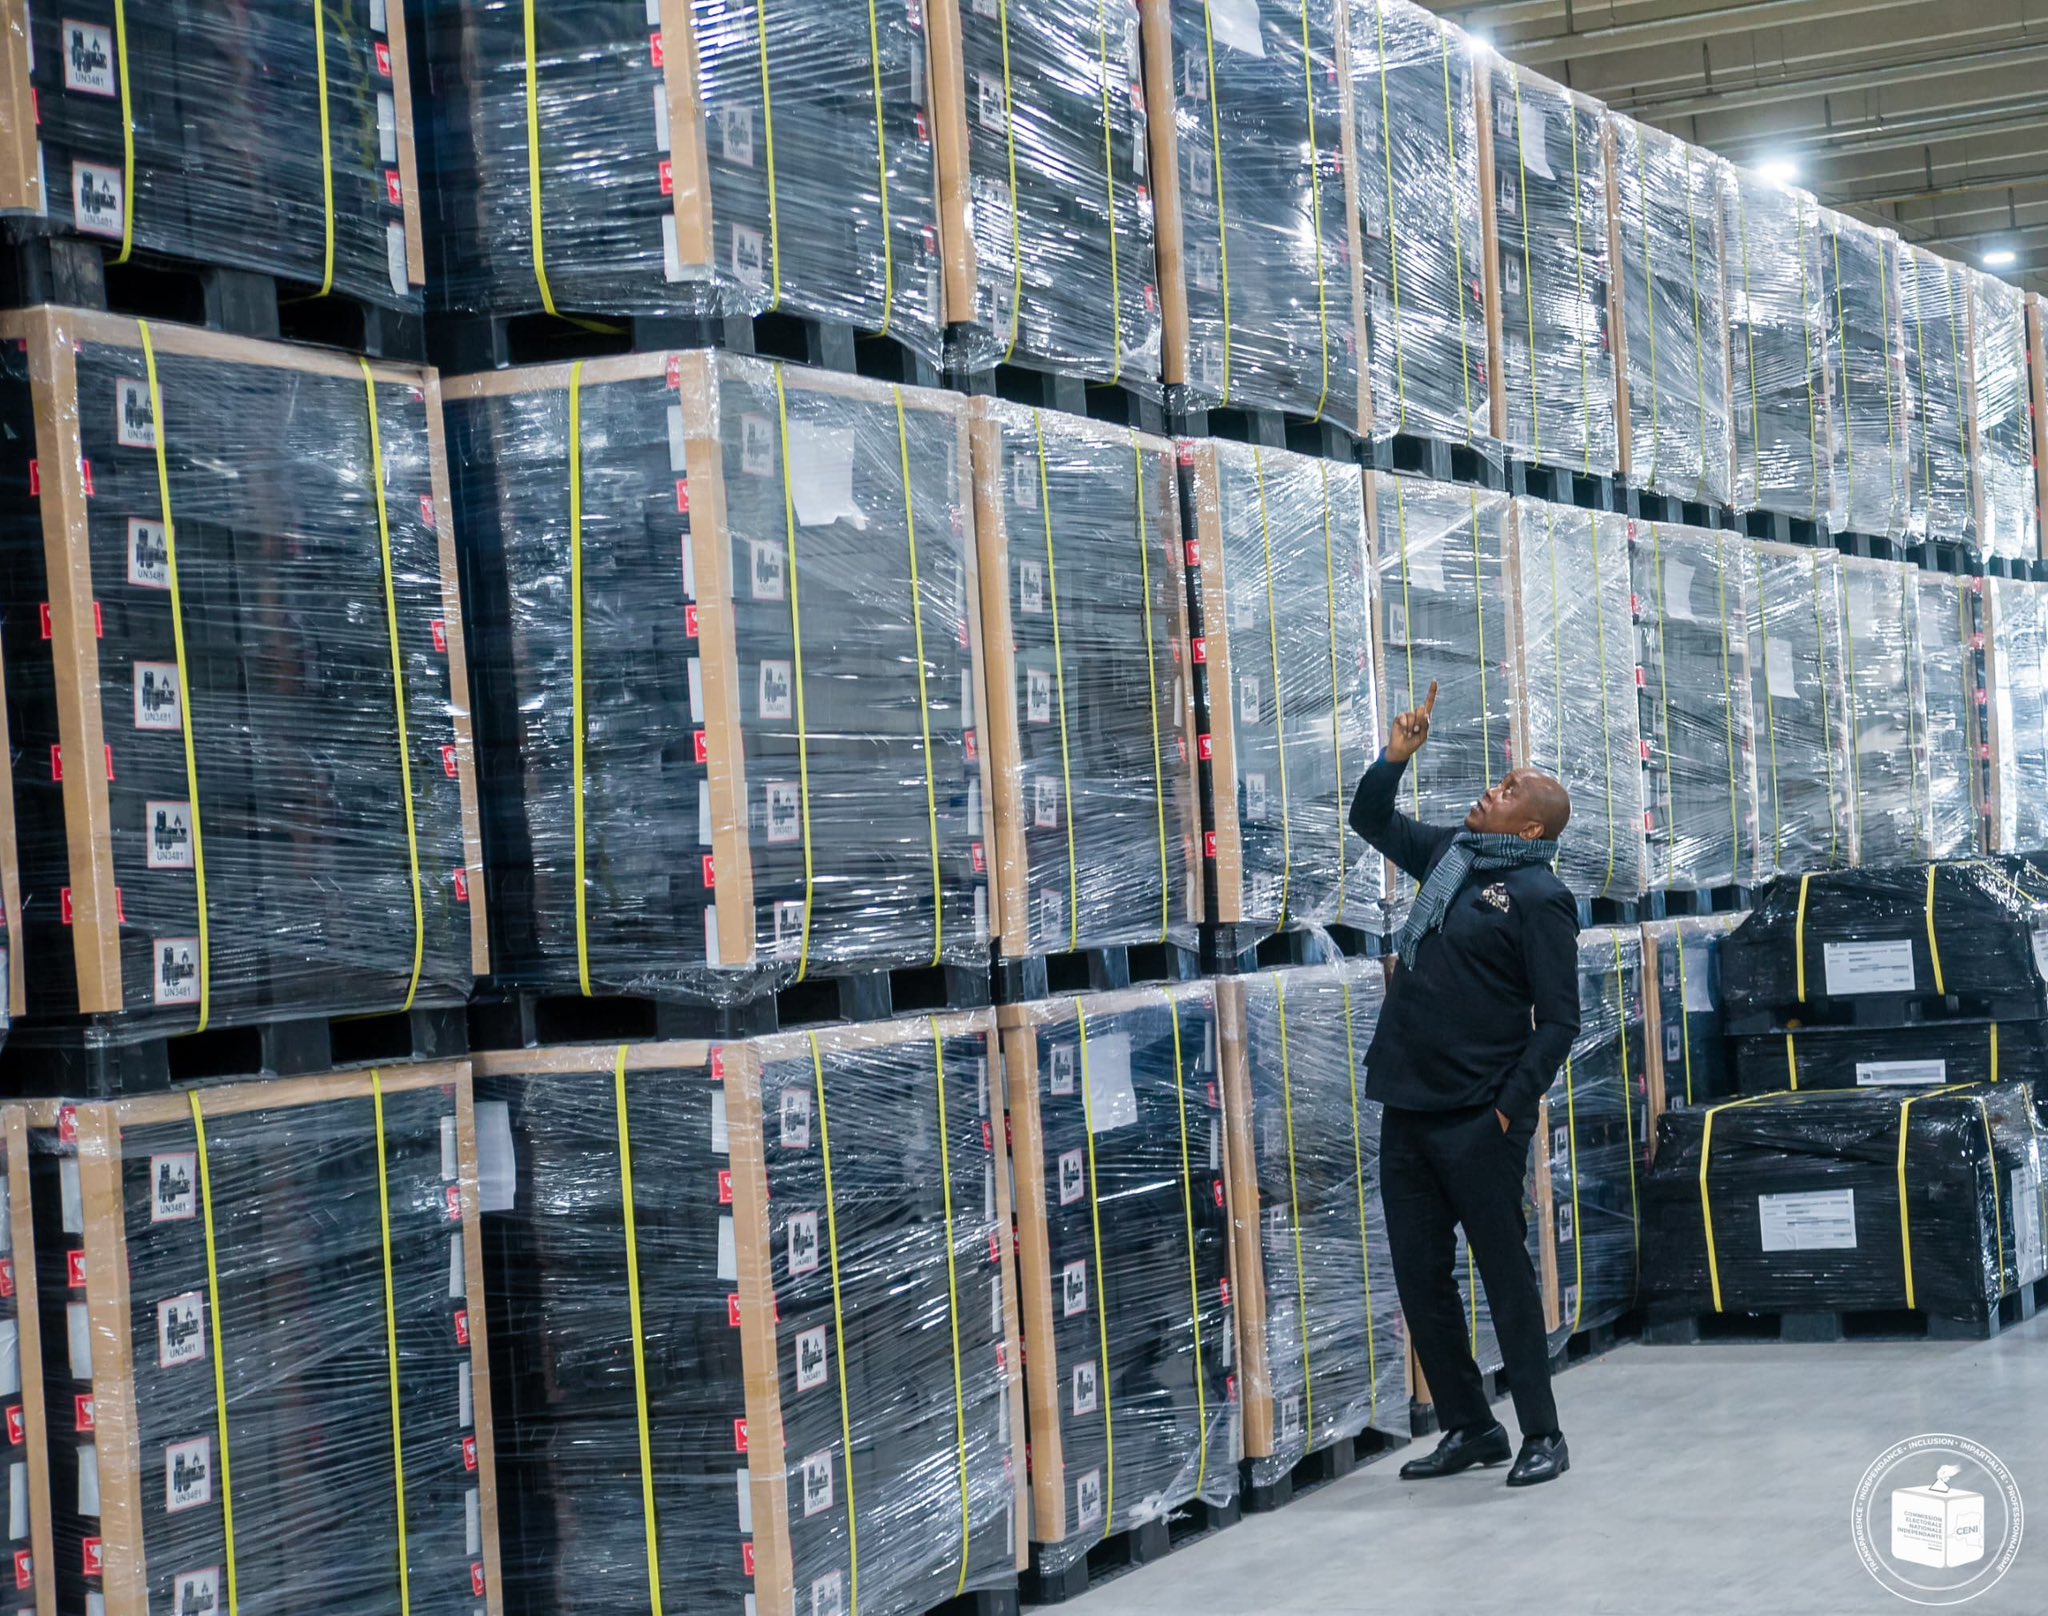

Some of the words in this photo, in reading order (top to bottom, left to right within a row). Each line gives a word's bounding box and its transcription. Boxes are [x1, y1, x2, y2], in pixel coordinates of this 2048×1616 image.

[75, 72, 104, 87] UN3481
[128, 430, 154, 441] UN3481
[138, 570, 165, 582] UN3481
[144, 712, 171, 722] UN3481
[157, 850, 184, 861] UN3481
[164, 987, 191, 997] UN3481
[160, 1203, 187, 1214] UN3481
[170, 1344, 196, 1358] UN3481
[176, 1490, 202, 1504] UN3481
